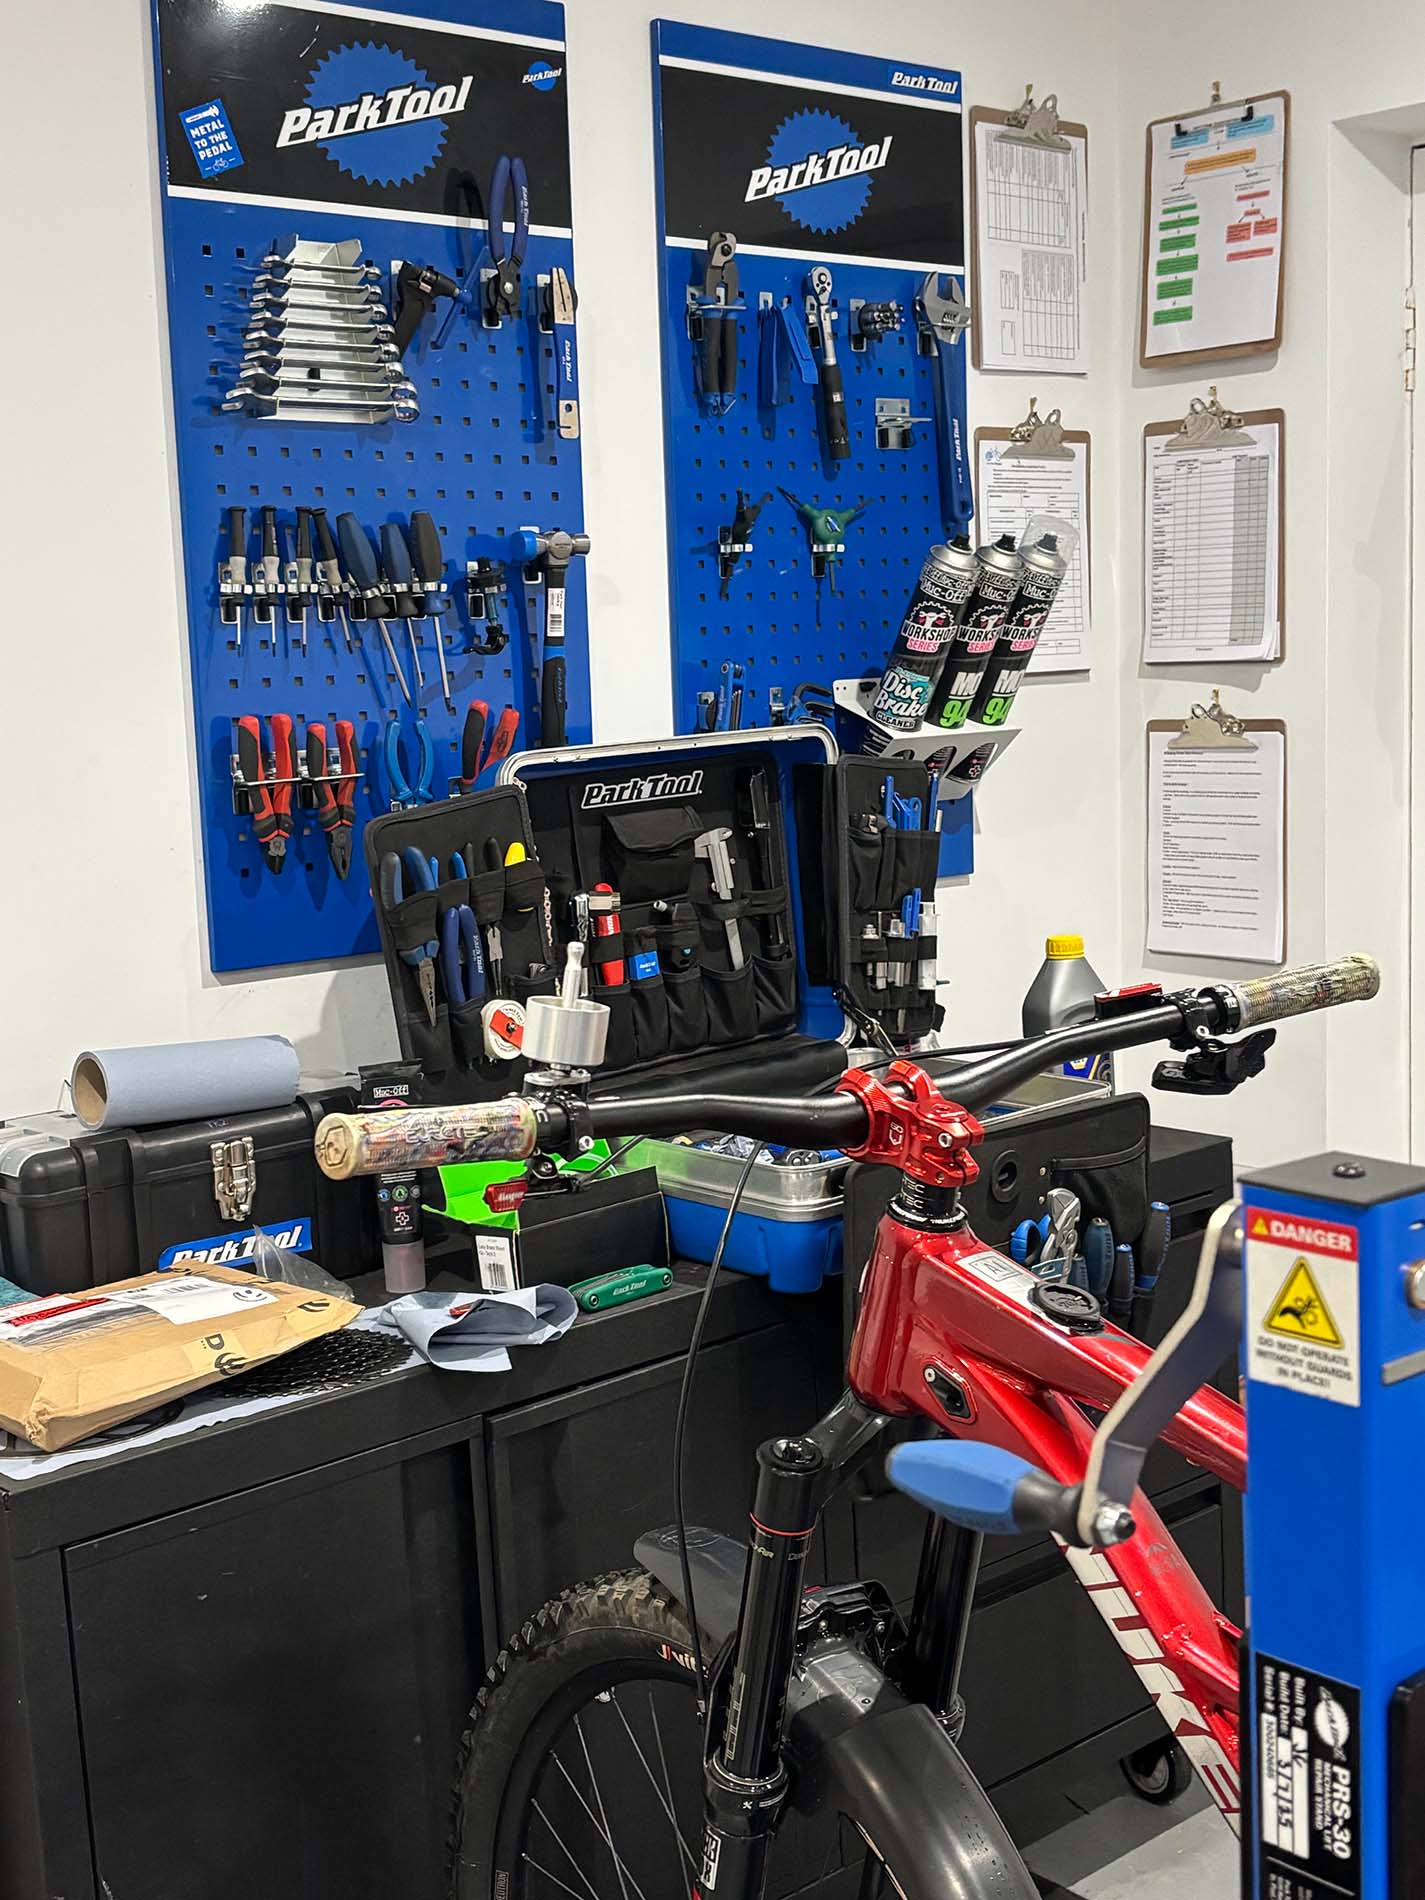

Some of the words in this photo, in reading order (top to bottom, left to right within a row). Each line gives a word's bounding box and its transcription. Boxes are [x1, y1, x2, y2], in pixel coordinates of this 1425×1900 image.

[189, 118, 225, 139] METAL
[275, 75, 475, 149] ParkTool
[194, 138, 208, 150] TO
[208, 131, 228, 144] THE
[198, 141, 233, 161] PEDAL
[744, 135, 894, 203] ParkTool
[907, 639, 939, 652] SERIES
[884, 667, 924, 701] Disc
[580, 770, 704, 810] ParkTool
[1269, 1219, 1353, 1253] DANGER
[1255, 1347, 1303, 1368] WITHOUT
[1306, 1359, 1353, 1382] GUARDS
[1258, 1335, 1274, 1347] DO
[1276, 1339, 1299, 1353] NOT
[1300, 1344, 1349, 1367] OPERATE
[1276, 1366, 1290, 1378] IN
[1049, 1529, 1241, 1846] NUKE
[1263, 1665, 1275, 1700] Serial
[1279, 1671, 1291, 1703] Build
[1294, 1676, 1306, 1706] Built
[1314, 1758, 1323, 1794] REPAIR
[1322, 1761, 1332, 1827] MECHANICAL
[1315, 1795, 1324, 1831] STAND
[1332, 1764, 1352, 1860] PRS-30
[1323, 1829, 1332, 1852] LIFT
